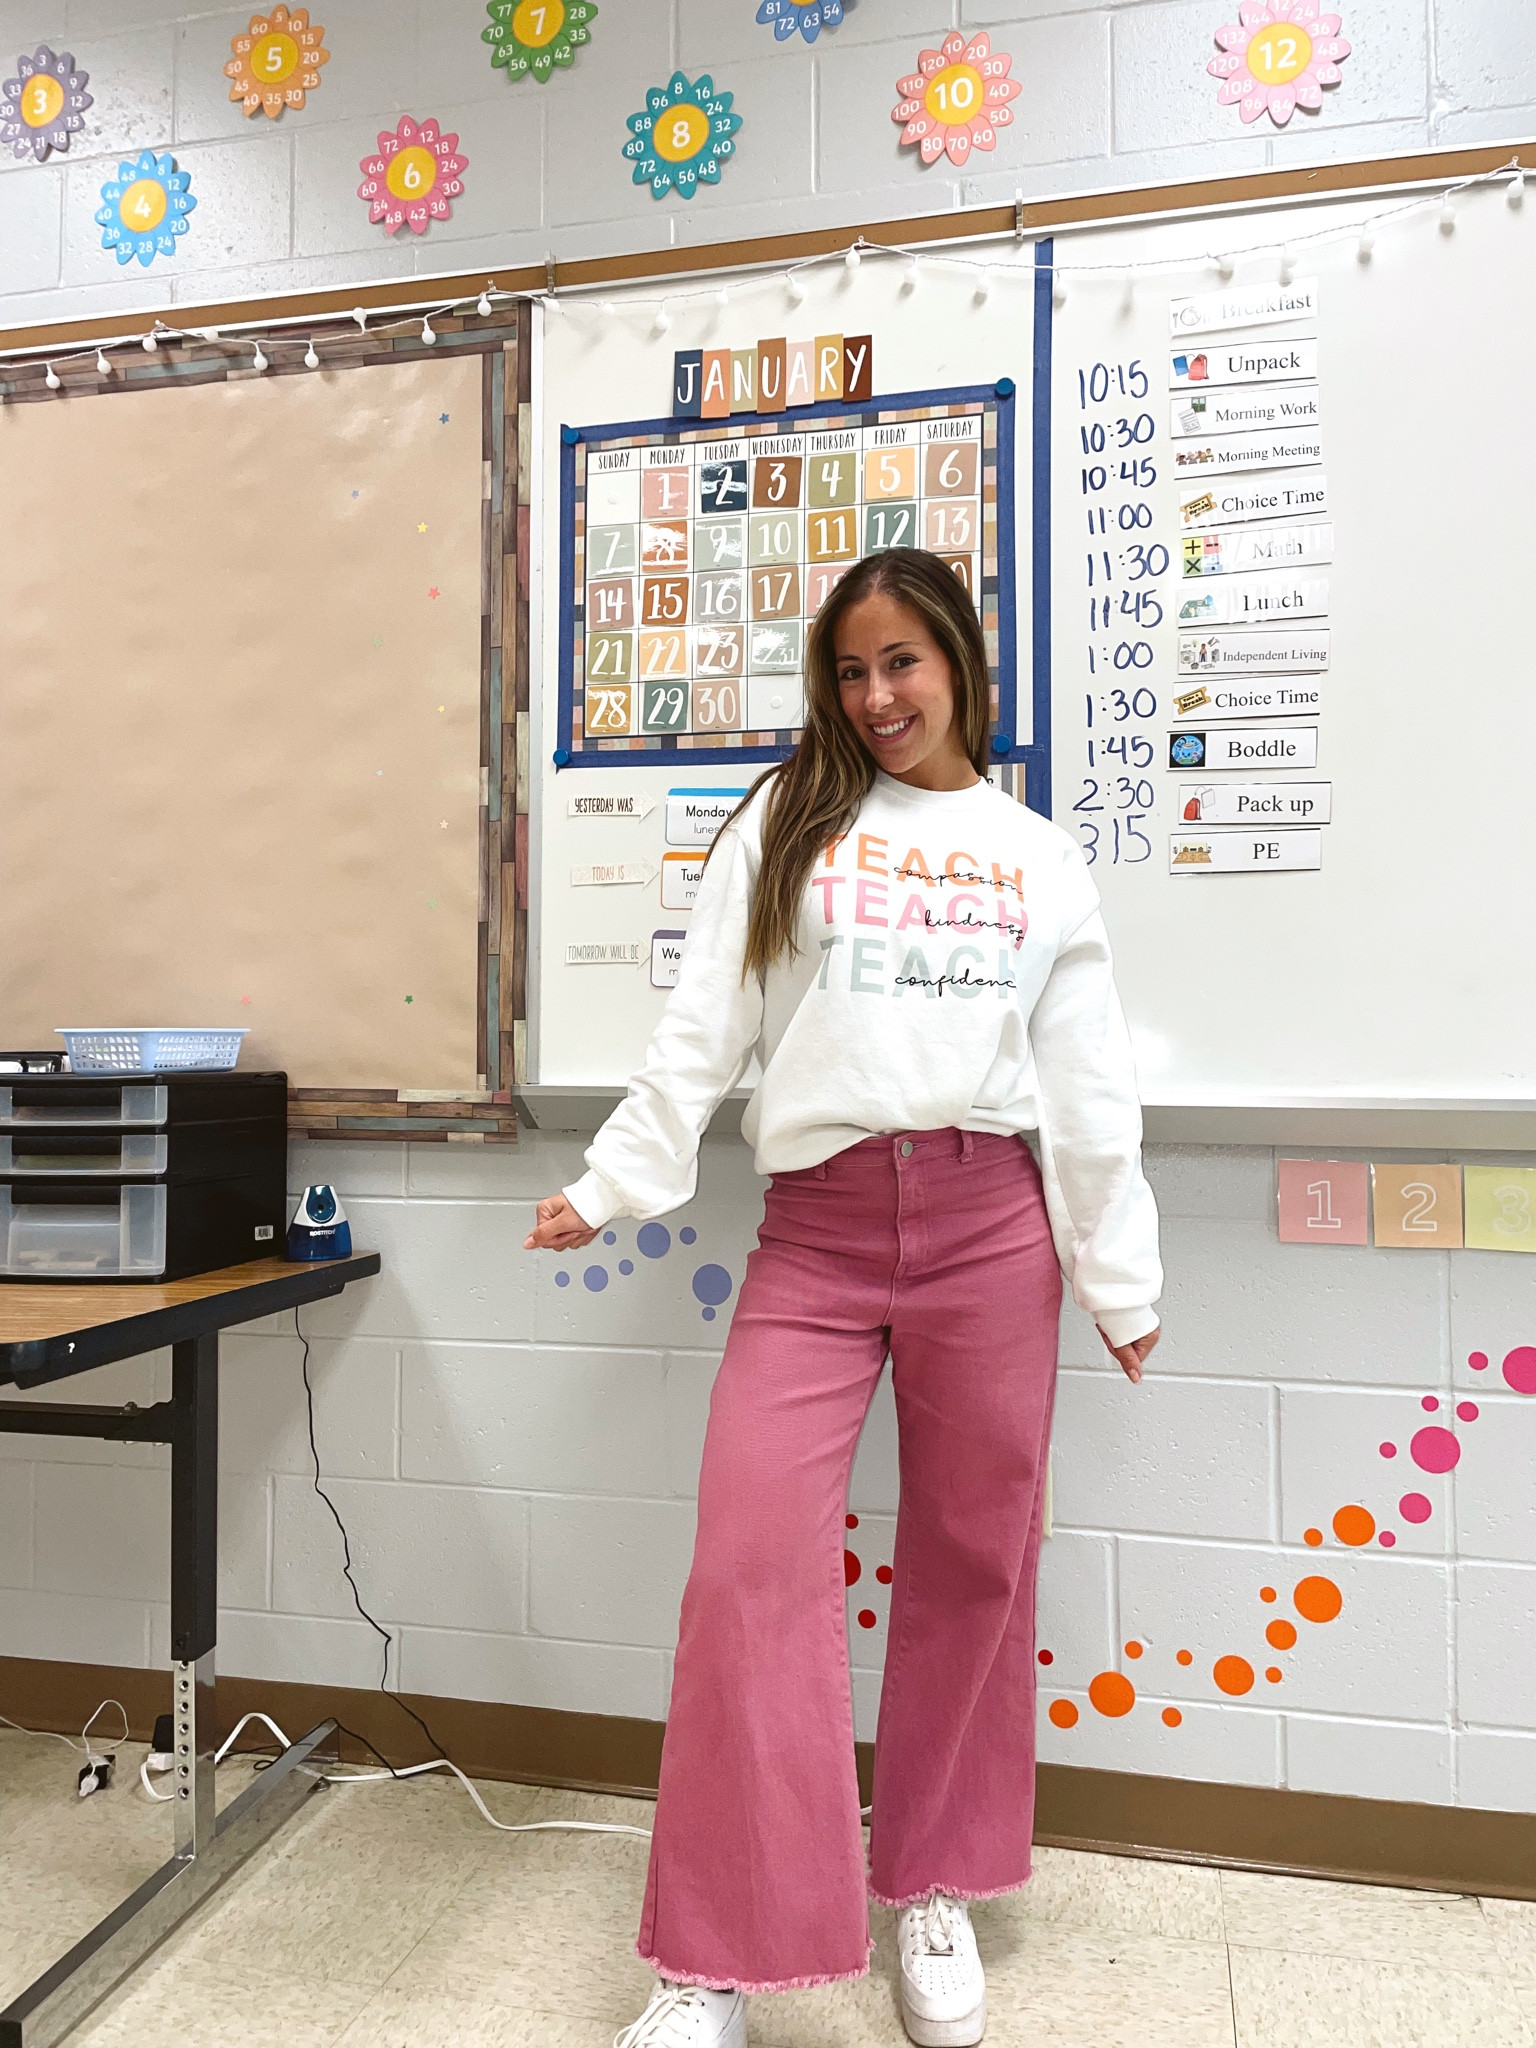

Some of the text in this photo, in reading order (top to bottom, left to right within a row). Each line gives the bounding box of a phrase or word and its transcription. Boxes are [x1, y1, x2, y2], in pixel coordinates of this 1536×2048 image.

[497, 4, 512, 17] 77
[570, 7, 586, 20] 28
[766, 2, 780, 14] 81
[824, 4, 840, 20] 54
[288, 20, 302, 32] 10
[530, 6, 546, 35] 7
[778, 18, 794, 30] 72
[804, 13, 819, 28] 63
[301, 34, 314, 45] 15
[487, 26, 503, 40] 70
[570, 29, 586, 42] 35
[498, 44, 513, 58] 63
[554, 46, 570, 60] 42
[946, 40, 962, 54] 10
[968, 45, 986, 60] 20
[1259, 38, 1298, 70] 12
[1318, 42, 1338, 56] 48
[266, 46, 282, 72] 5
[302, 52, 320, 64] 20
[511, 58, 527, 70] 56
[535, 56, 550, 68] 49
[922, 56, 945, 72] 120
[57, 62, 64, 74] 6
[984, 61, 1002, 76] 30
[302, 74, 318, 86] 25
[902, 78, 924, 93] 110
[674, 82, 682, 94] 8
[696, 86, 710, 100] 16
[934, 77, 974, 110] 10
[989, 84, 1010, 98] 40
[33, 89, 48, 114] 3
[70, 96, 83, 107] 12
[285, 90, 302, 102] 30
[652, 95, 668, 109] 96
[706, 101, 723, 116] 24
[894, 100, 920, 119] 100
[1244, 98, 1262, 110] 96
[990, 109, 1010, 124] 50
[404, 124, 411, 136] 6
[635, 118, 652, 132] 88
[715, 118, 731, 132] 32
[908, 121, 926, 136] 90
[53, 132, 67, 144] 18
[420, 130, 434, 144] 12
[672, 120, 690, 148] 8
[972, 130, 992, 144] 60
[384, 140, 398, 154] 72
[434, 142, 449, 155] 18
[626, 141, 644, 156] 80
[712, 141, 731, 155] 40
[922, 137, 942, 152] 80
[948, 136, 968, 152] 70
[368, 160, 384, 174] 66
[442, 159, 458, 172] 24
[640, 160, 656, 174] 72
[698, 160, 716, 175] 48
[404, 162, 421, 188] 6
[654, 174, 670, 188] 64
[678, 169, 695, 184] 56
[168, 178, 180, 190] 12
[362, 182, 377, 196] 60
[442, 181, 460, 195] 30
[134, 194, 152, 218] 4
[174, 197, 187, 210] 16
[374, 200, 388, 214] 54
[431, 200, 446, 214] 36
[386, 211, 402, 224] 48
[410, 208, 426, 220] 42
[1228, 352, 1302, 375] Unpack
[677, 344, 868, 404] JANUARY
[1079, 360, 1149, 410] 10:15
[1216, 401, 1318, 422] Morning Work
[1080, 414, 1155, 454] 10:30
[598, 420, 974, 470] SUNDAY MONDAY TUESDAY WEDNESDAY THURSDAY FRIDAY SATURDAY
[1218, 444, 1320, 464] Morning Meeting
[658, 449, 963, 510] 1 2 3 4 5 6
[1082, 456, 1157, 494] 10:45
[1222, 494, 1278, 513] Choice
[1282, 490, 1324, 505] Time
[1088, 503, 1152, 535] 11:00
[604, 532, 620, 568] 7
[710, 526, 728, 562] 9
[758, 522, 792, 556] 10
[814, 516, 851, 556] 11
[872, 509, 910, 548] 12
[932, 507, 970, 546] 13
[1252, 539, 1303, 560] Math
[1088, 544, 1170, 586] 11:30
[594, 587, 627, 624] 14
[647, 583, 683, 619] 15
[700, 576, 737, 616] 16
[758, 572, 792, 612] 17
[1243, 590, 1304, 612] Lunch
[1090, 589, 1164, 631] 11:45
[590, 639, 626, 675] 21
[646, 636, 681, 675] 22
[698, 632, 740, 669] 23
[1088, 641, 1154, 674] 1:00
[1223, 649, 1327, 664] Independent Living
[1215, 692, 1272, 708] Choice
[1276, 690, 1319, 704] Time
[590, 686, 736, 728] 28 29 30
[1086, 687, 1156, 728] 1:30
[1088, 736, 1154, 768] 1:45
[1228, 740, 1296, 758] Boddle
[1072, 776, 1154, 810] 2:30
[574, 797, 634, 813] YESTERDAY WAS
[686, 804, 732, 818] Monday
[1237, 795, 1314, 816] Pack up
[1252, 842, 1281, 860] PE
[592, 864, 624, 882] TODAY IS
[681, 868, 702, 881] Tue
[824, 832, 1024, 904] TEACH
[894, 866, 1023, 894] compassion
[812, 876, 1028, 952] TEACH
[925, 910, 1024, 942] kindness
[568, 944, 639, 960] TOMORROW WILL BE
[895, 968, 1016, 998] confidenc
[1306, 1180, 1342, 1228] 1
[1400, 1182, 1438, 1232] 2
[1492, 1184, 1532, 1236] 3
